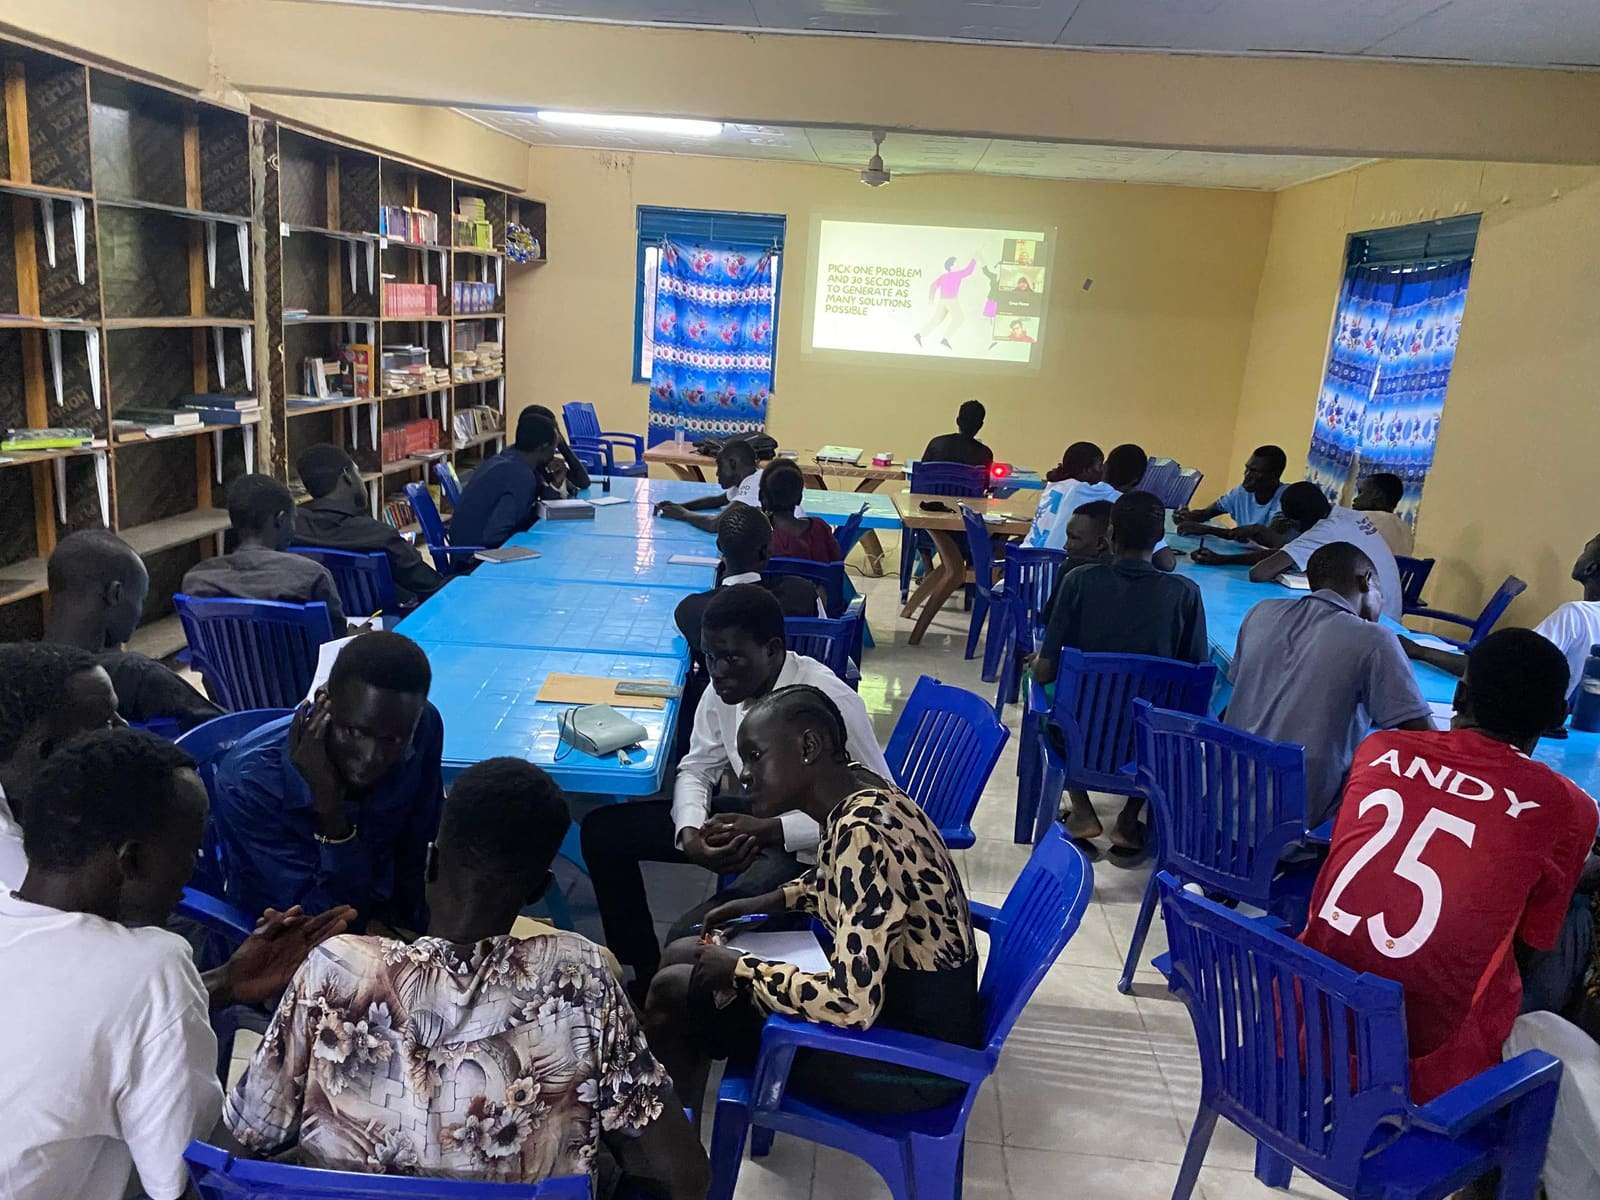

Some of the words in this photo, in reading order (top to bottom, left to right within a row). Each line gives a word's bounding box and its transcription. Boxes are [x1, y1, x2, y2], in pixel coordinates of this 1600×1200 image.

[828, 263, 851, 274] PICK
[853, 265, 874, 275] ONE
[876, 266, 922, 278] PROBLEM
[827, 274, 849, 284] AND
[851, 276, 863, 284] 30
[864, 277, 911, 288] SECONDS
[827, 284, 840, 293] TO
[842, 285, 893, 297] GENERATE
[895, 289, 910, 298] AS
[825, 294, 856, 305] MANY
[858, 296, 912, 309] SOLUTIONS
[825, 304, 869, 316] POSSIBLE
[1369, 749, 1541, 819] ANDY
[1318, 788, 1476, 959] 25
